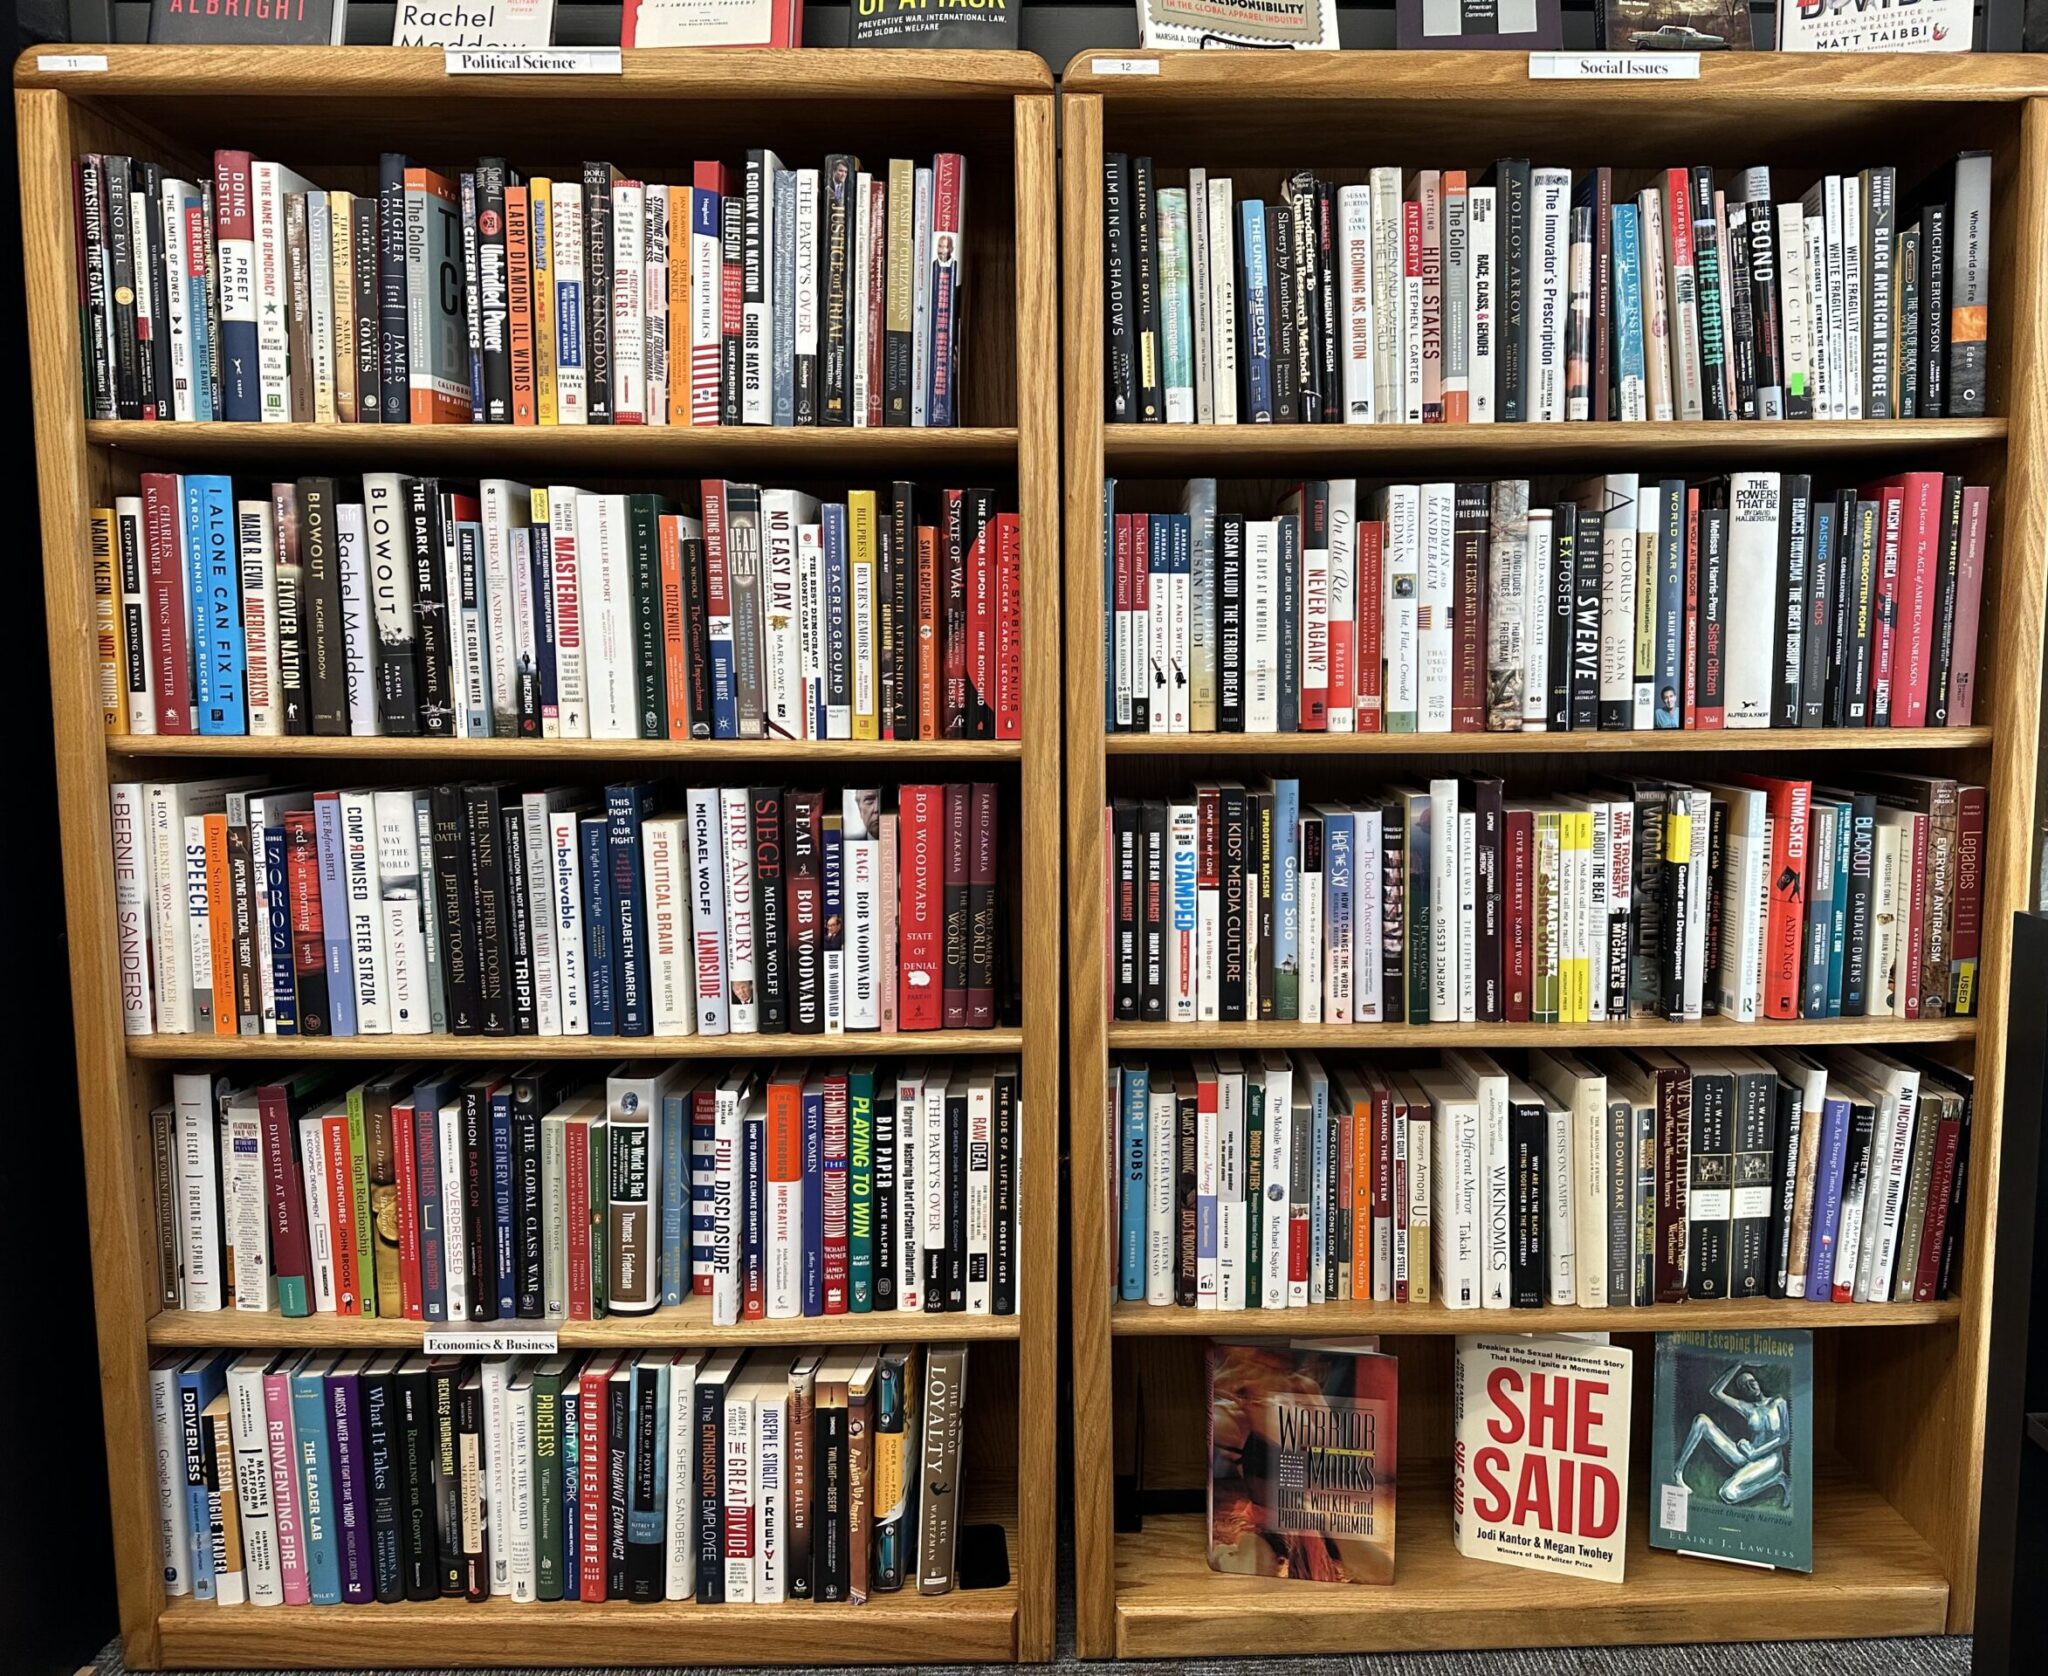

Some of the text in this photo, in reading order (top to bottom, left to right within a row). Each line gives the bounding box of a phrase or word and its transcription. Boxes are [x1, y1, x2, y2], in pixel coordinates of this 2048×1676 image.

[403, 5, 494, 27] Rachel
[858, 15, 903, 30] PREVENTIVE
[905, 14, 924, 24] WAR,
[926, 13, 987, 23] INTERNATIONAL
[858, 22, 940, 39] AND GLOBAL WELFARE
[1816, 25, 1928, 50] MATT TAIBBI
[67, 59, 78, 68] 11
[462, 54, 576, 69] Political Science
[1121, 62, 1131, 71] 12
[1580, 60, 1669, 75] Social Issues
[218, 164, 230, 225] JUSTICE
[233, 172, 245, 217] DOING
[726, 202, 740, 260] COLLUSION
[941, 162, 952, 228] VAN JONES
[83, 169, 104, 306] CRASHING THE GATE
[508, 203, 527, 313] LARRY DIAMOND
[800, 178, 812, 334] THE PARTY'S OVER
[1105, 163, 1123, 336] JUMPING at SHADOWS
[1408, 205, 1418, 272] INTEGRITY
[1752, 220, 1773, 282] BOND
[222, 248, 233, 312] BHARARA
[237, 258, 248, 302] PREET
[480, 243, 506, 352] Unbridled Power
[615, 269, 628, 317] RULERS
[1422, 248, 1439, 359] HIGH STAKES
[1541, 189, 1558, 365] The Innovator's Prescription
[1872, 228, 1888, 397] BLACK AMERICAN REFUGEE
[199, 345, 207, 370] BRUCE
[746, 314, 759, 390] CHRIS HAYES
[210, 505, 226, 576] ALONE
[371, 488, 395, 614] BLOWOUT
[413, 484, 430, 592] THE DARK SIDE
[770, 511, 792, 610] NO EASY DAY
[215, 587, 228, 629] CAN
[554, 537, 579, 648] MASTERMIND
[1557, 537, 1572, 616] EXPOSED
[217, 641, 232, 673] FIX
[1307, 569, 1326, 672] NEVER AGAIN?
[1575, 596, 1598, 680] SWERVE
[220, 684, 233, 702] IT
[1875, 678, 1890, 715] JACKSON
[1789, 788, 1807, 858] UNMASKED
[1852, 816, 1873, 878] BLACKOUT
[1958, 831, 1982, 889] Legacies
[114, 803, 143, 1010] BERNIE SANDERS
[187, 845, 209, 917] SPEECH
[730, 802, 752, 964] FIRE AND FURY
[796, 804, 815, 1024] FEAR BOB WOODWARD
[1174, 852, 1196, 931] STAMPED
[1226, 822, 1242, 982] KIDS' MEDIA CULTURE
[1612, 923, 1620, 988] MICHAELS
[1674, 865, 1686, 980] Gender and Development
[356, 915, 376, 1005] PETER STRZOK
[514, 958, 531, 1011] TRIPPI
[566, 950, 577, 1006] KATY TUR
[697, 931, 721, 998] LANDSLIDE
[1437, 919, 1445, 1006] LAWRENCE LESSIG
[1959, 975, 1969, 1004] USED
[467, 1094, 476, 1146] FASHION
[877, 1116, 892, 1188] BAD PAPER
[1131, 1078, 1144, 1181] SMART MOBS
[1783, 1102, 1802, 1210] WHITE WORKING CLASS
[269, 1124, 288, 1234] DIVERSITY AT WORK
[852, 1096, 870, 1238] PLAYING TO WIN
[1615, 1110, 1624, 1208] DEEP DOWN DARK
[714, 1138, 731, 1274] FULL DISCLOSURE
[1459, 1222, 1471, 1261] Takaki
[1493, 1166, 1506, 1271] WIKINOMICS
[621, 1212, 635, 1289] Thomas L. Friedman
[429, 1339, 555, 1350] Economics & Business
[1477, 1342, 1625, 1369] Breaking the Sexual Harassment Story
[183, 1392, 200, 1481] DRIVERLESS
[536, 1394, 554, 1456] PRICELESS
[927, 1366, 946, 1474] LOYALTY
[1486, 1366, 1609, 1458] SHE
[270, 1421, 297, 1569] REINVENTING FIRE
[305, 1440, 322, 1540] THE LEADER LAB
[728, 1458, 748, 1556] GREAT DIVIDE
[794, 1432, 803, 1529] LIVES PER GALLON
[1473, 1445, 1620, 1539] SAID
[1477, 1527, 1613, 1563] Jodi Kantor & Megan Twohey
[1669, 1531, 1714, 1545] ELAINE
[1739, 1540, 1795, 1558] LAWLESS
